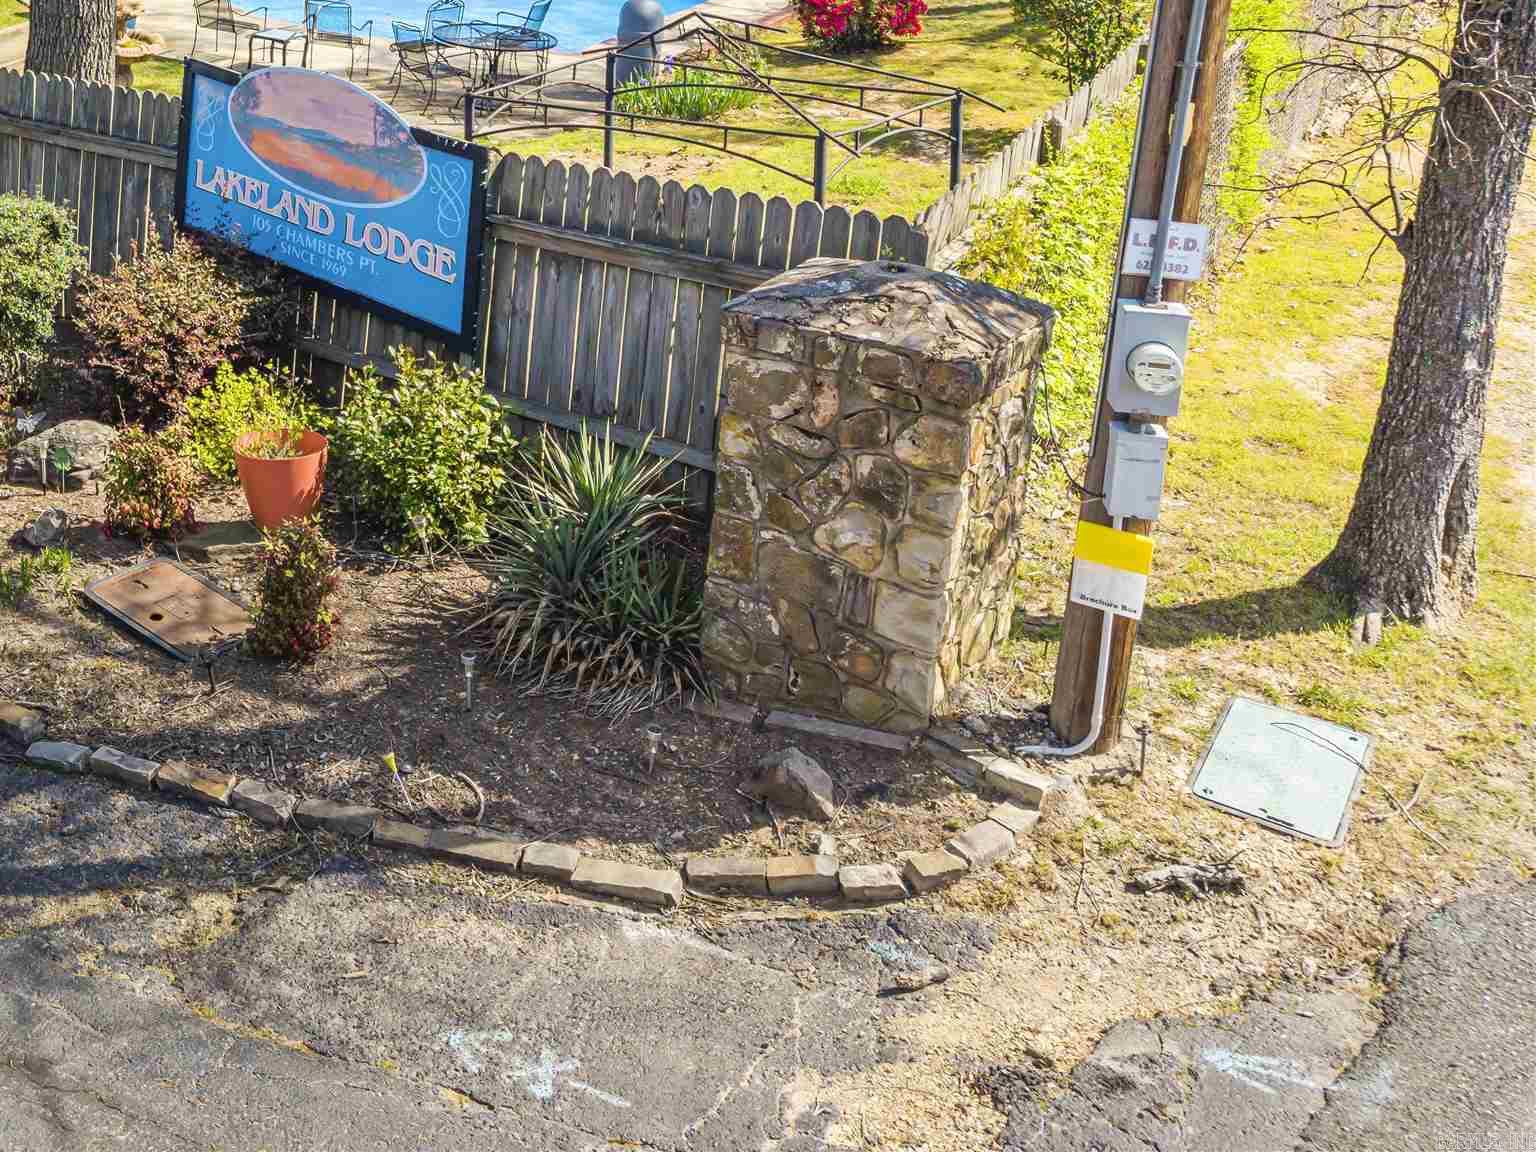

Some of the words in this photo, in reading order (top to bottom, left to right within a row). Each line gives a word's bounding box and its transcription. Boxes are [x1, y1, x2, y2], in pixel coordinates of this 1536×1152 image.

[195, 159, 335, 236] LAKELAND
[345, 212, 457, 284] LODGE
[251, 215, 272, 233] 105
[276, 224, 355, 266] CHAMBERS
[280, 242, 316, 267] SINCE
